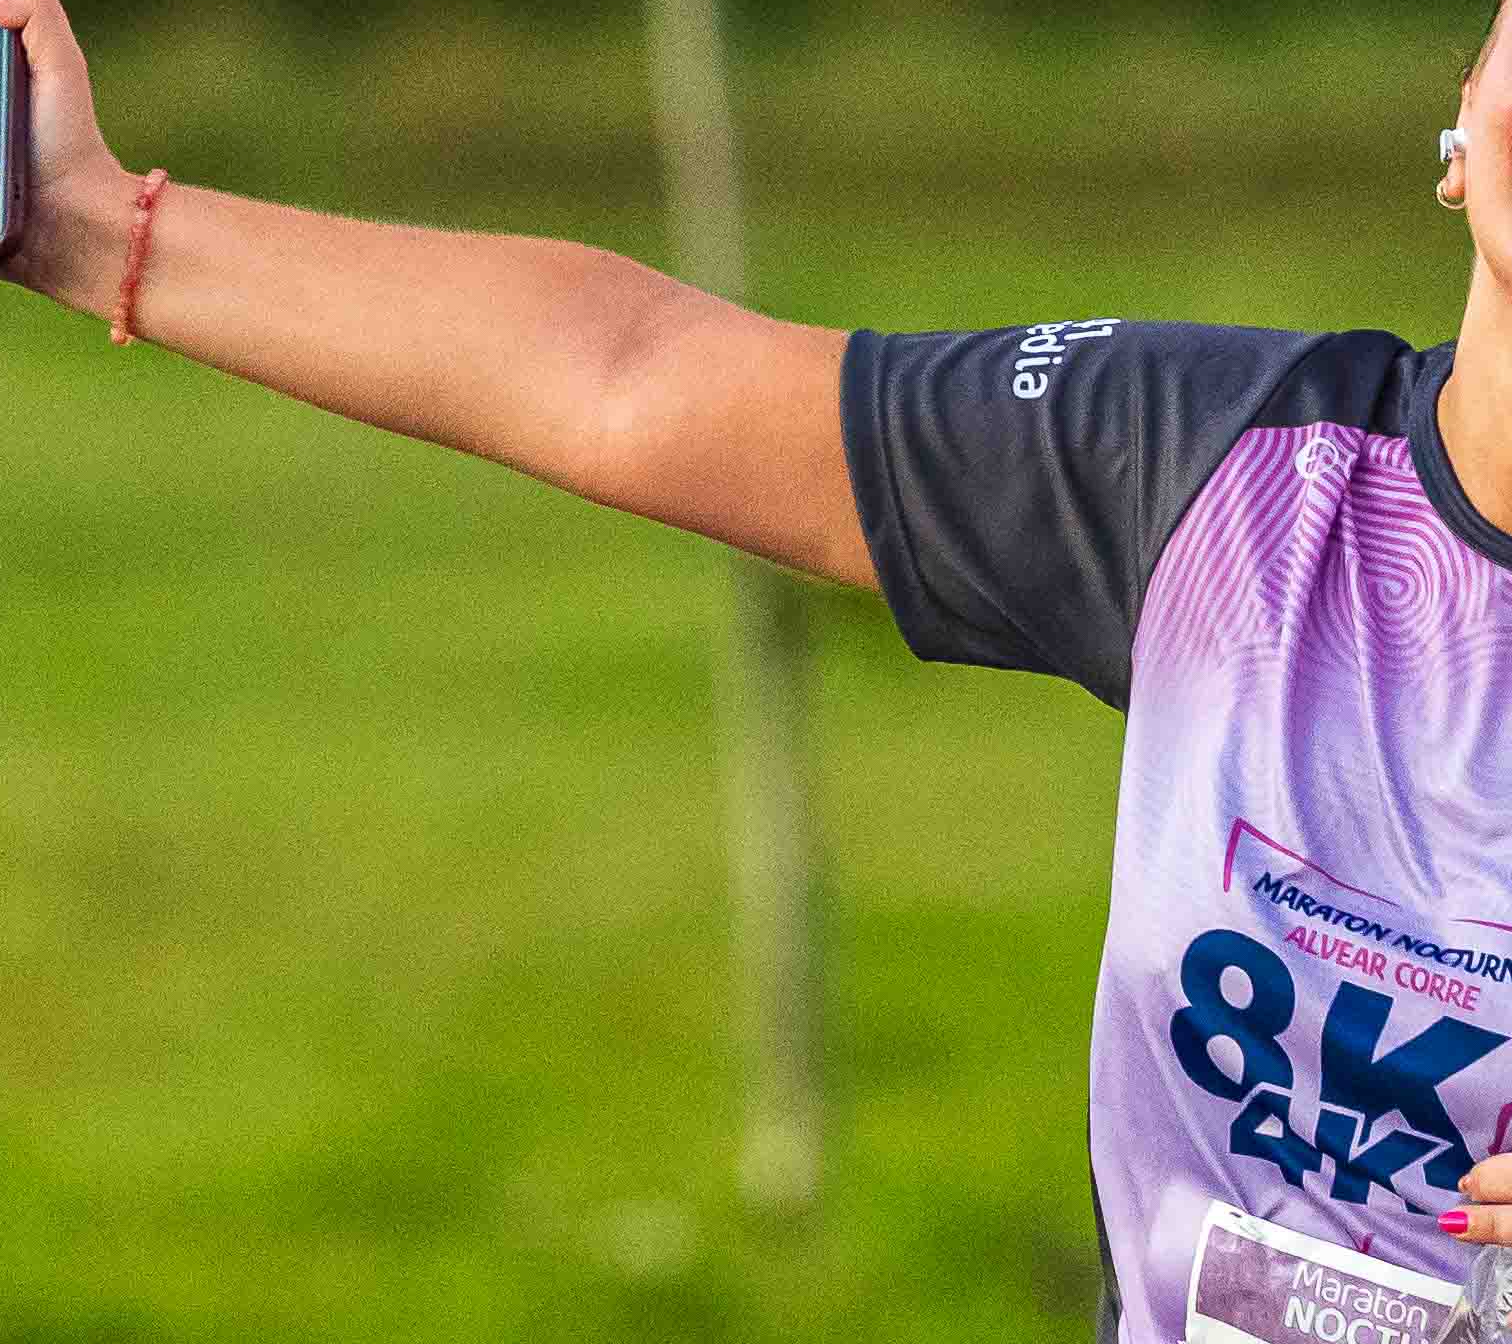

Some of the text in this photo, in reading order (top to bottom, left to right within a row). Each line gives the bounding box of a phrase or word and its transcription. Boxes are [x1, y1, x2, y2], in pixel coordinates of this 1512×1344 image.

[1013, 321, 1067, 400] edia
[1253, 872, 1399, 943] MARATON
[1285, 925, 1482, 1012] ALVEAR CORRE
[1170, 929, 1512, 1193] 8K
[1292, 1260, 1429, 1332] Maratón
